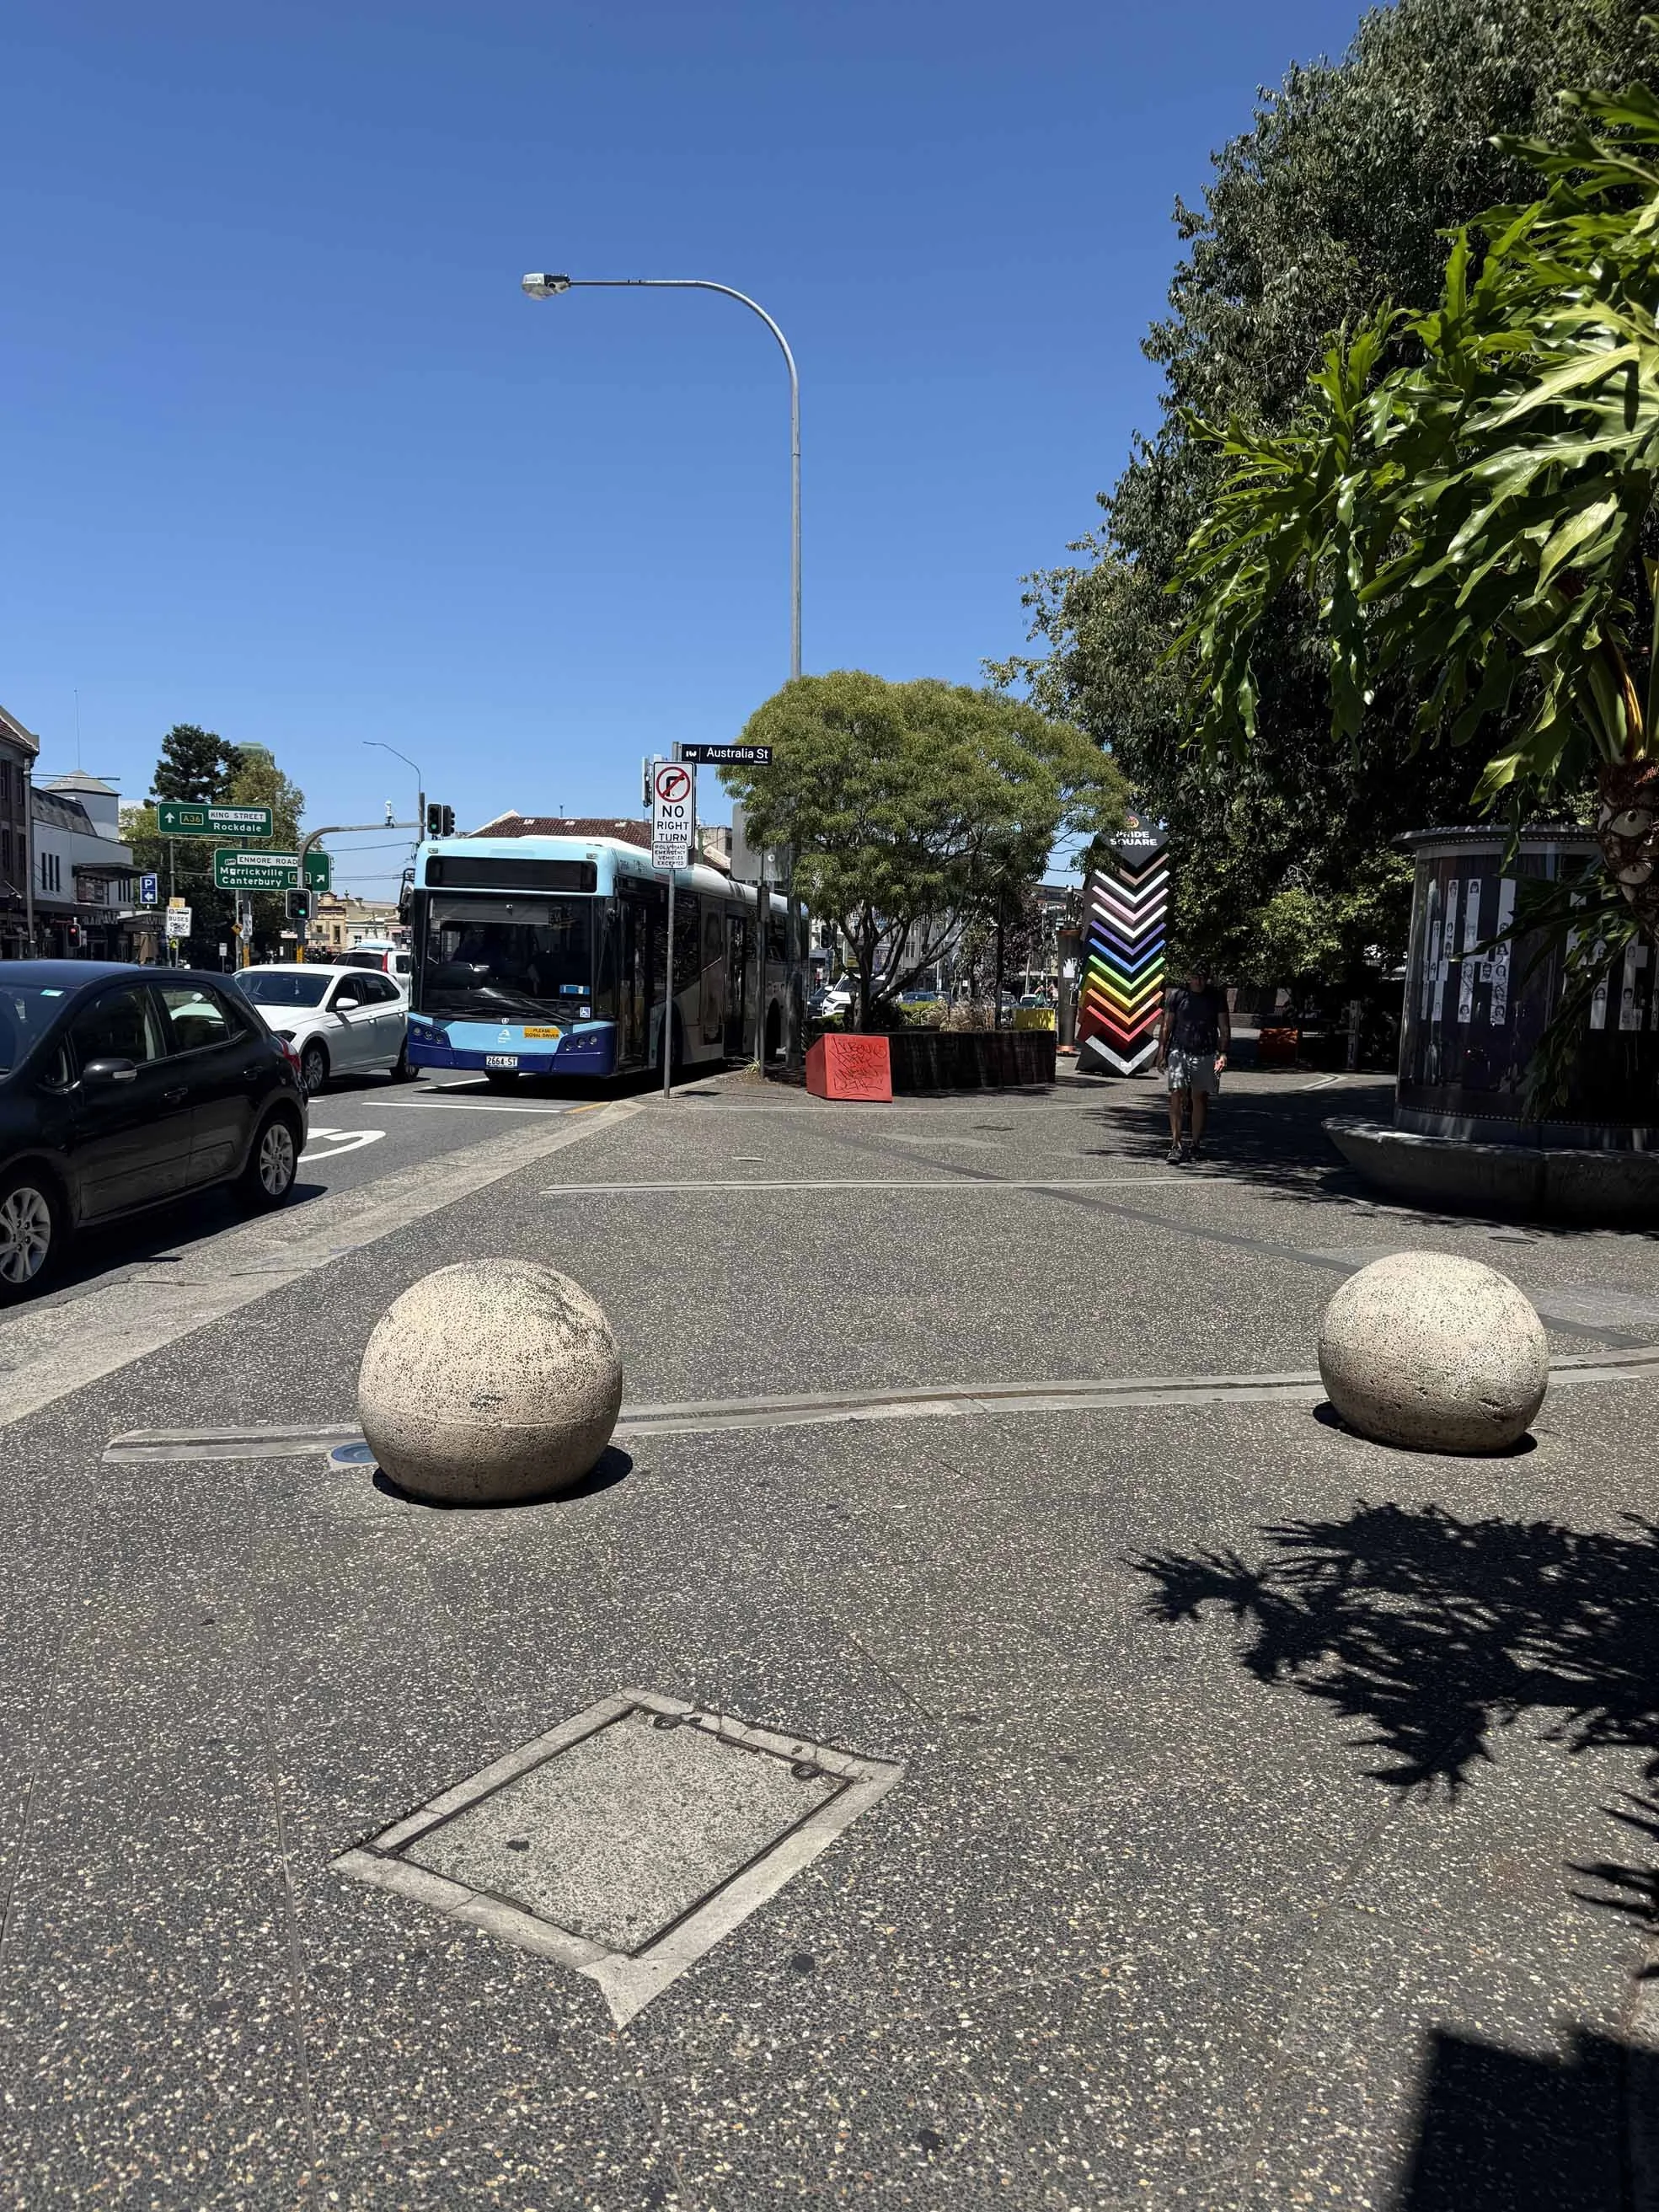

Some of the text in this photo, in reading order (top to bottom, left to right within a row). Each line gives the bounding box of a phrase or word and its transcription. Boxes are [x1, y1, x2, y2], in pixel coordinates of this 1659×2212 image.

[706, 747, 768, 759] Australia St
[233, 812, 264, 821] STREET
[661, 805, 684, 818] NO
[182, 815, 201, 823] A36
[213, 822, 262, 833] Rockdale
[657, 821, 689, 830] RIGHT
[238, 856, 271, 865] ENMORE
[220, 866, 284, 876] Mrrickville
[144, 879, 153, 889] P
[222, 876, 282, 887] Canterbury
